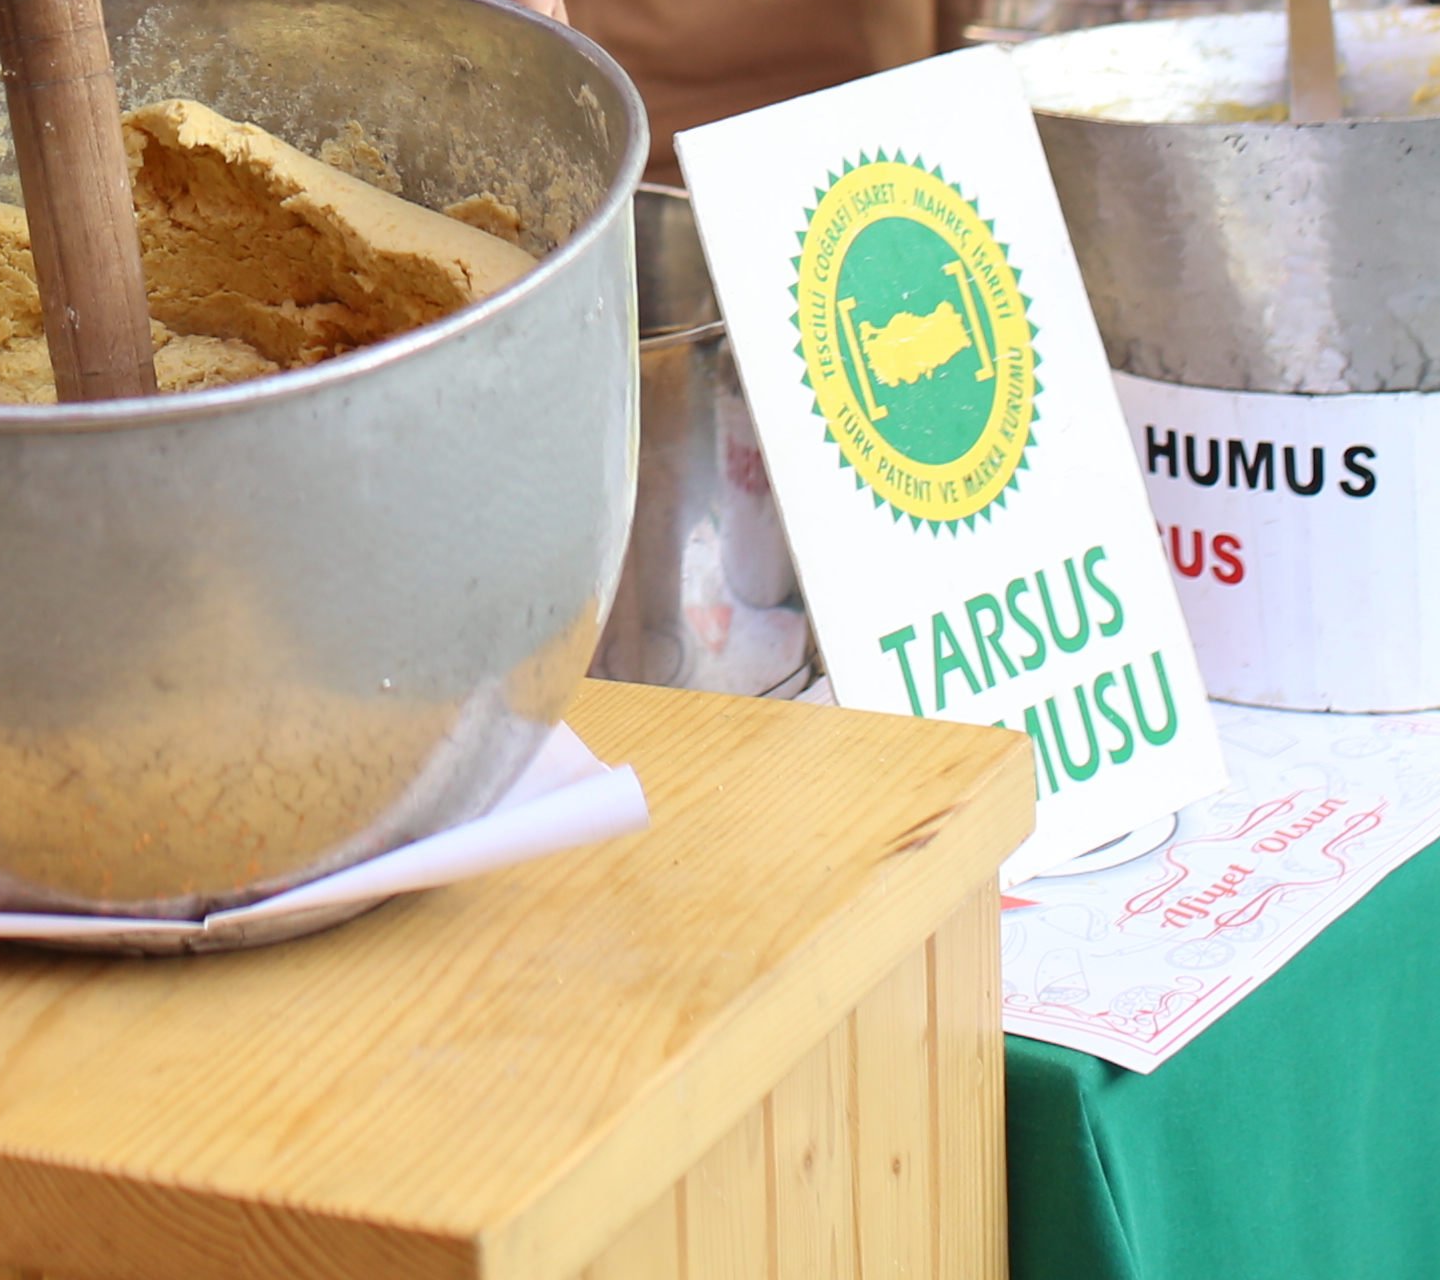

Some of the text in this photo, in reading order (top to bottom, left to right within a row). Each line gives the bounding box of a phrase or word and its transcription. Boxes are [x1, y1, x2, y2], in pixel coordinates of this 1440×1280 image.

[814, 198, 853, 283] COĞRAFİ
[808, 288, 837, 381] TESCİLLİ
[836, 401, 875, 462] TÜRK
[876, 455, 933, 503] PATENT
[938, 478, 960, 504] VE
[961, 443, 1008, 498] MARKA
[998, 346, 1024, 444] KURUMU
[1145, 424, 1378, 498] HUMUS
[878, 544, 1125, 718] TARSUS
[1160, 797, 1349, 929] Afiyet Olsun
